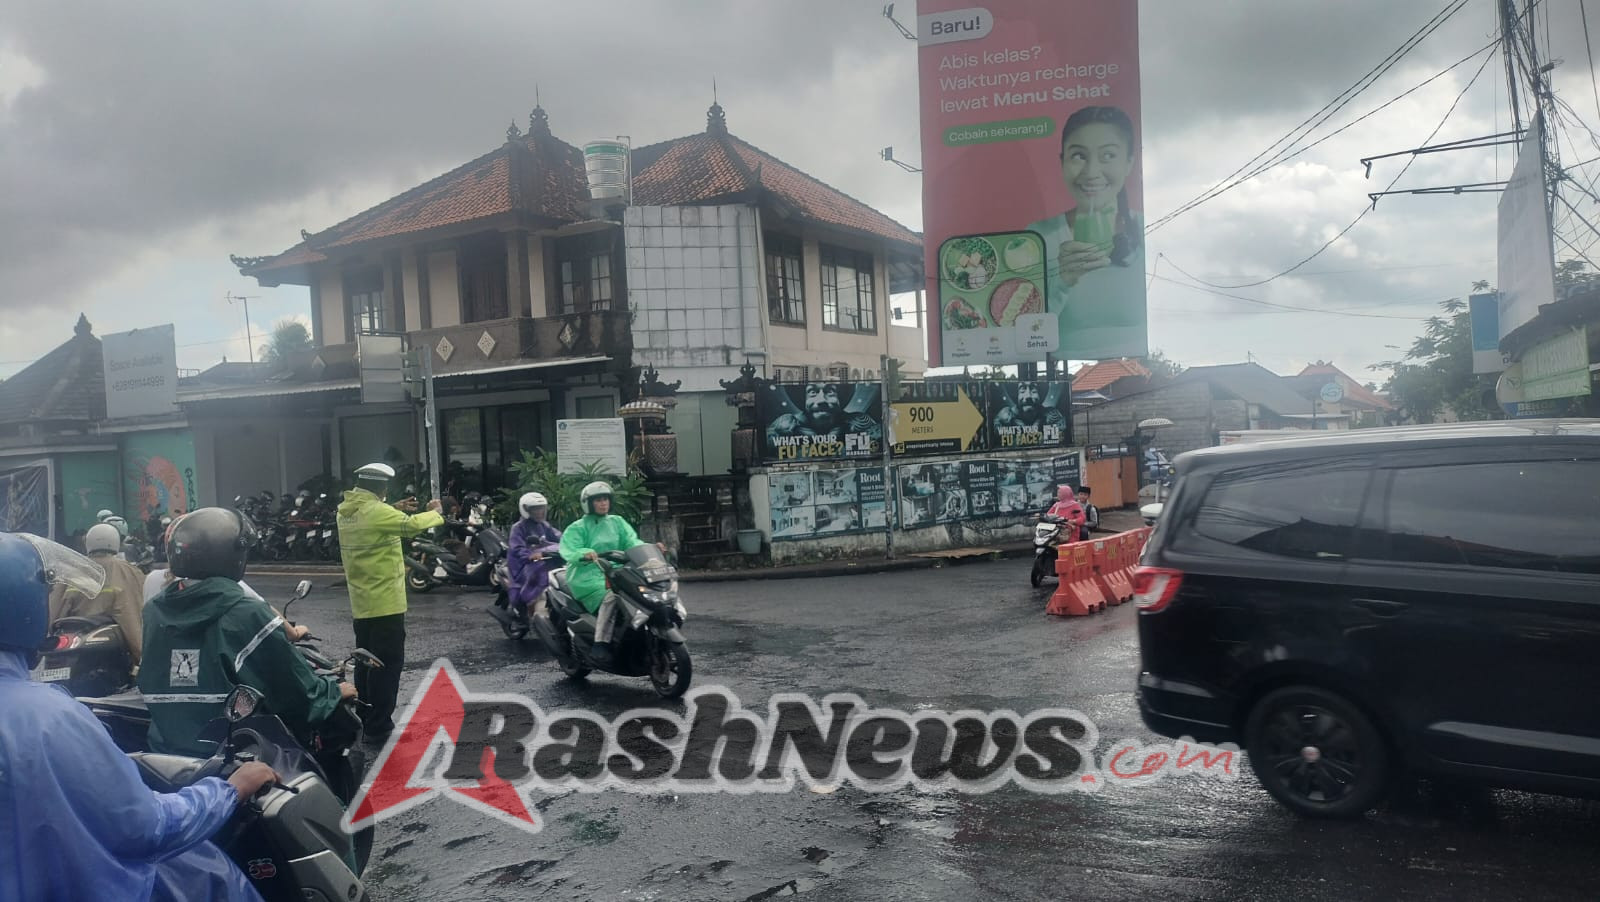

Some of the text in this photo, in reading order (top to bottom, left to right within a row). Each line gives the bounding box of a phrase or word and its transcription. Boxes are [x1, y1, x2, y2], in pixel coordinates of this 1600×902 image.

[930, 15, 981, 35] Baru!
[939, 46, 1042, 71] Abis kelas?
[939, 62, 1120, 92] Waktunya recharge
[940, 82, 1111, 113] lewat Menu Sehat
[949, 121, 1048, 142] Cobain sekarang!
[1027, 340, 1048, 348] Sehat
[909, 406, 934, 423] 900
[911, 426, 934, 434] METERS
[997, 425, 1039, 436] WHAT'S YOUR
[772, 434, 837, 447] WHAT'S YOUR
[1001, 434, 1014, 446] FU
[778, 441, 844, 460] FU FACE?
[969, 463, 986, 474] Root
[860, 472, 881, 483] Root
